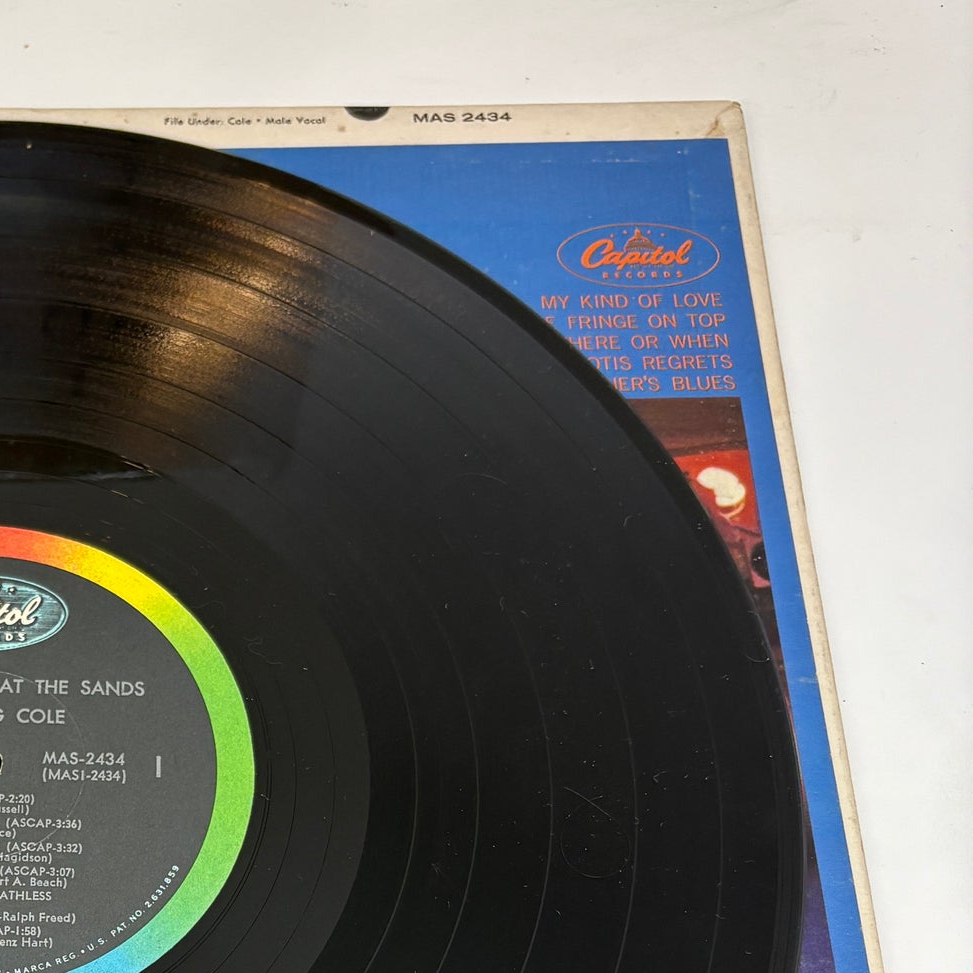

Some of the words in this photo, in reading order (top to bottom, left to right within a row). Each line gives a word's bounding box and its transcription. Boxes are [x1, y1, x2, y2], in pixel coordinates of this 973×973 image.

[227, 116, 252, 126] Cole
[265, 116, 292, 125] Male
[295, 116, 326, 125] Vocal
[413, 112, 455, 123] MAS
[462, 111, 512, 123] 2434
[580, 239, 693, 271] Capitol
[602, 270, 684, 280] RECORDS
[540, 295, 569, 309] MY
[580, 294, 629, 309] KIND
[637, 293, 663, 308] OF
[673, 293, 723, 308] LOVE
[568, 315, 637, 330] FRINGE
[647, 314, 677, 329] ON
[685, 313, 726, 328] TOP
[631, 335, 659, 349] OR
[669, 334, 729, 349] WHEN
[643, 355, 733, 370] REGRETS
[672, 375, 737, 391] BLUES
[0, 678, 24, 693] AT
[35, 679, 69, 695] THE
[80, 680, 145, 697] SANDS
[16, 707, 66, 724] COLE
[42, 751, 126, 766] MAS-2434
[6, 818, 82, 830] (ASCAP-3:36)
[7, 842, 83, 854] (ASCAP-3:32)
[0, 865, 75, 878] (ASCAP-3:07)
[12, 875, 26, 887] A.
[30, 877, 68, 889] Beach)
[38, 912, 76, 924] Freed)
[21, 937, 53, 949] Hart)
[55, 952, 80, 965] REG.
[110, 922, 131, 937] PAT.
[129, 910, 146, 923] NO.
